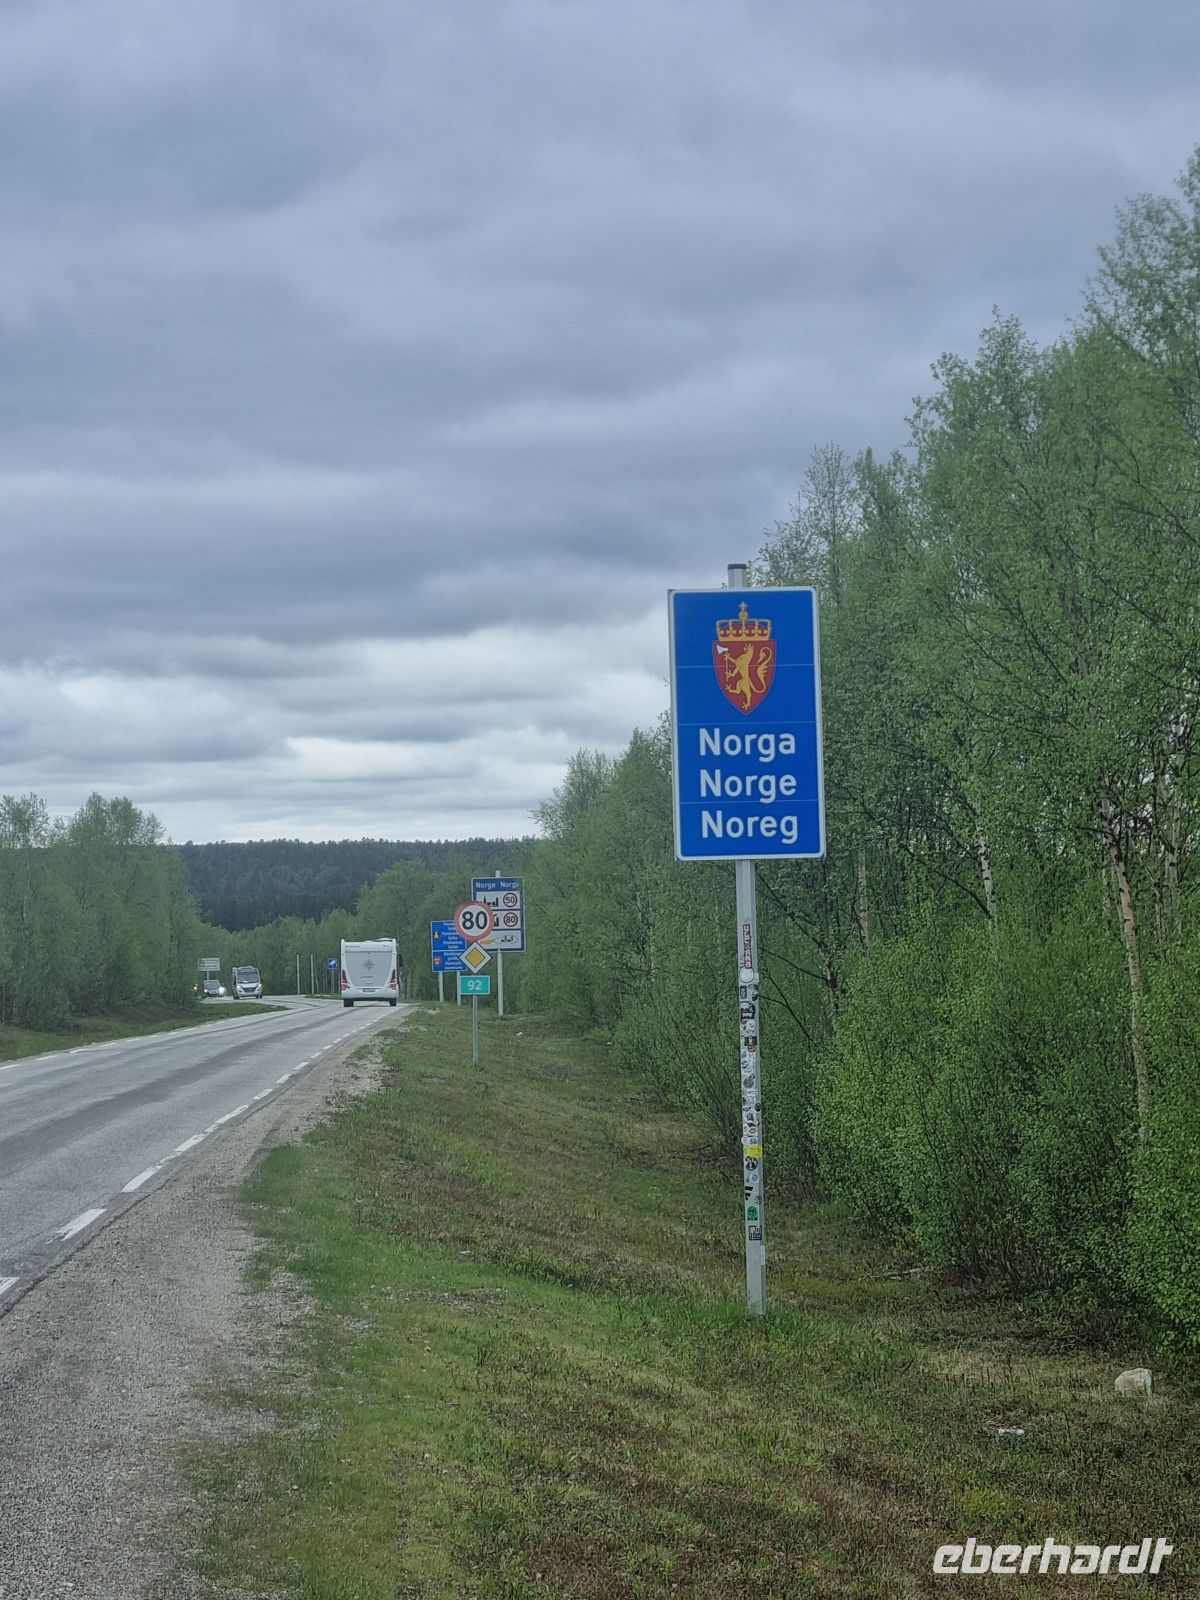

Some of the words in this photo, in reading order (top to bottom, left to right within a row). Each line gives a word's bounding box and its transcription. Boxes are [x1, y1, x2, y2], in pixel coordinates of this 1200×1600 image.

[699, 728, 796, 762] Norga
[700, 769, 797, 804] Norge
[701, 810, 799, 844] Noreg
[475, 881, 496, 890] Norge
[505, 896, 515, 904] 50
[461, 910, 488, 930] 80
[505, 915, 516, 924] 80
[467, 980, 482, 991] 92
